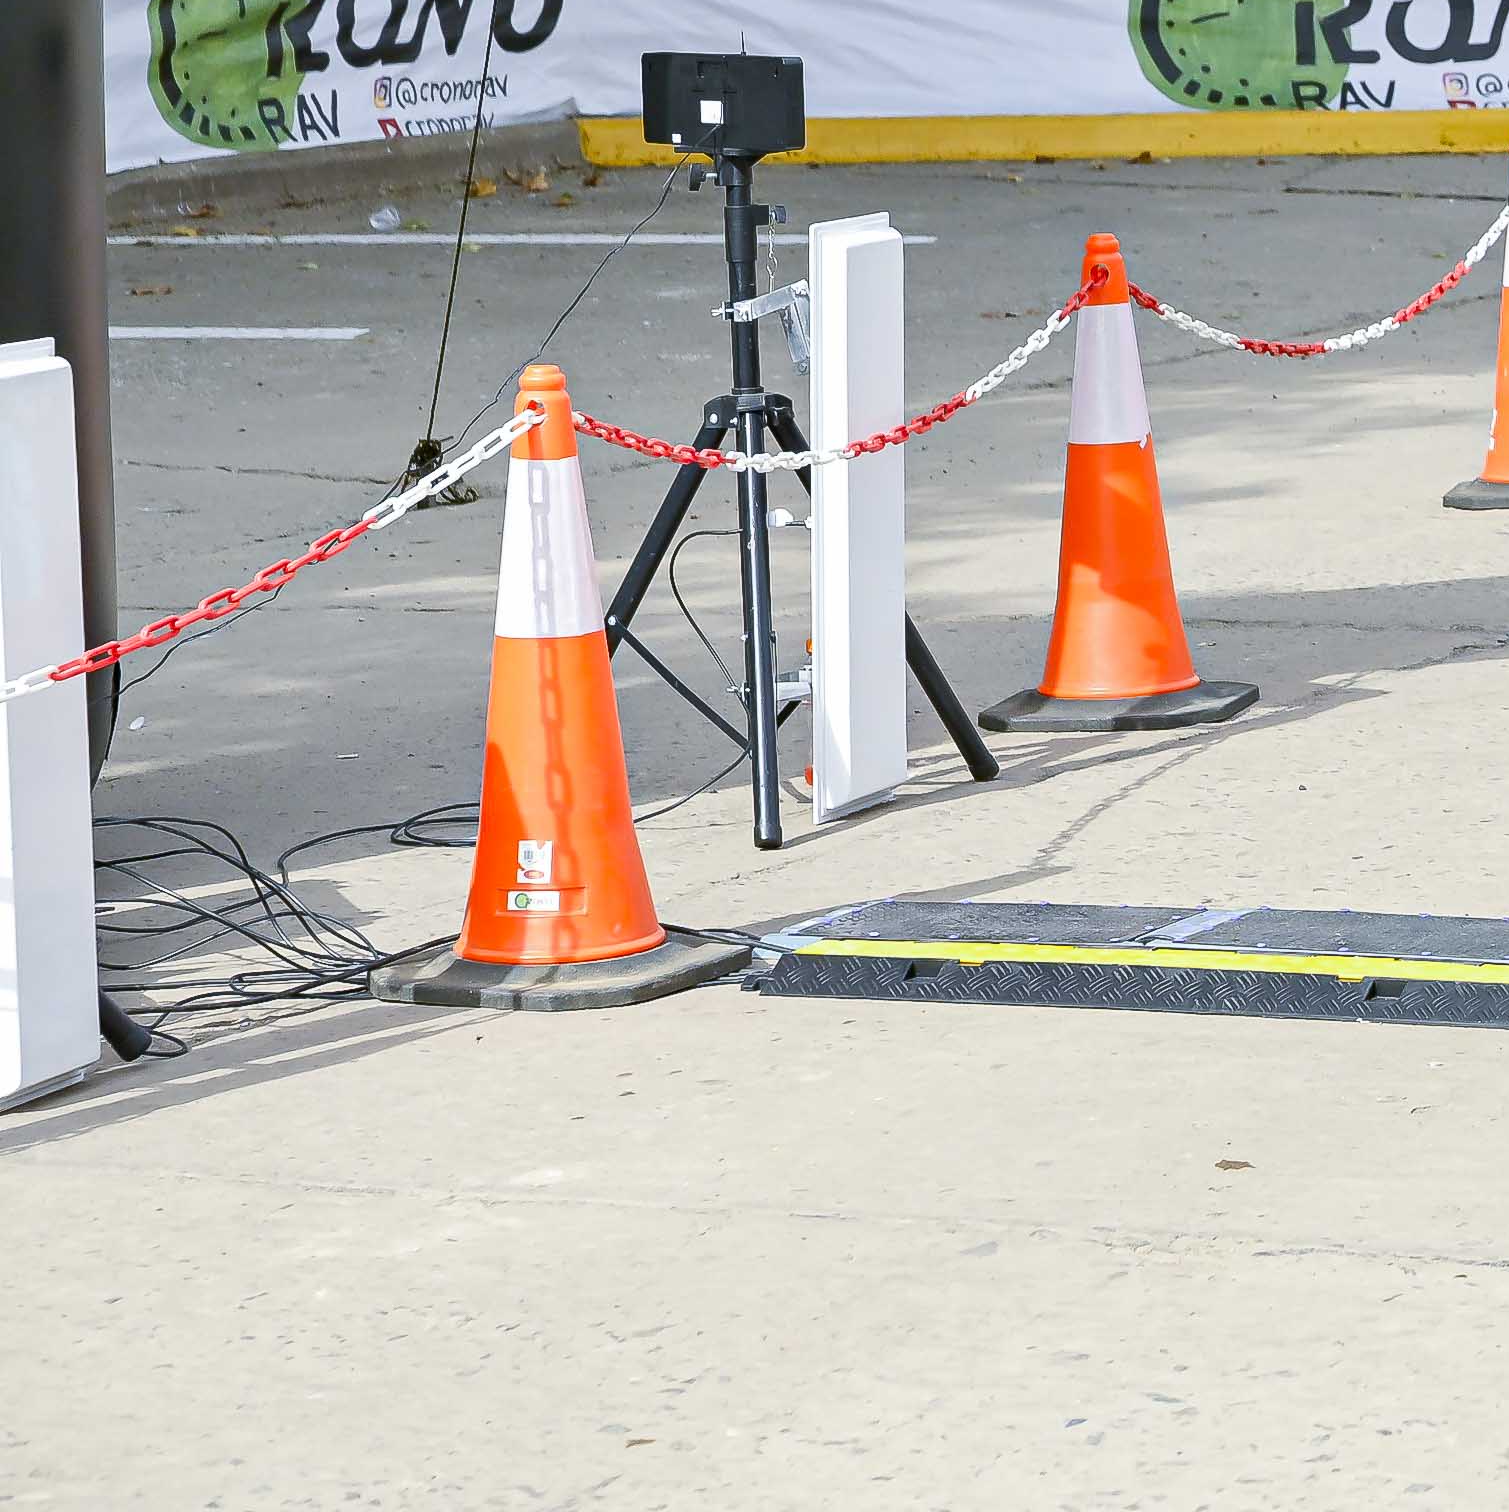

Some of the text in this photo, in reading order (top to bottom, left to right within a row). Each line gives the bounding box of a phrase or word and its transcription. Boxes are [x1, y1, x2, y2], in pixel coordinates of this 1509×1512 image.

[395, 74, 508, 110] @cronorav
[1291, 79, 1396, 111] RAV
[257, 89, 341, 145] RAV
